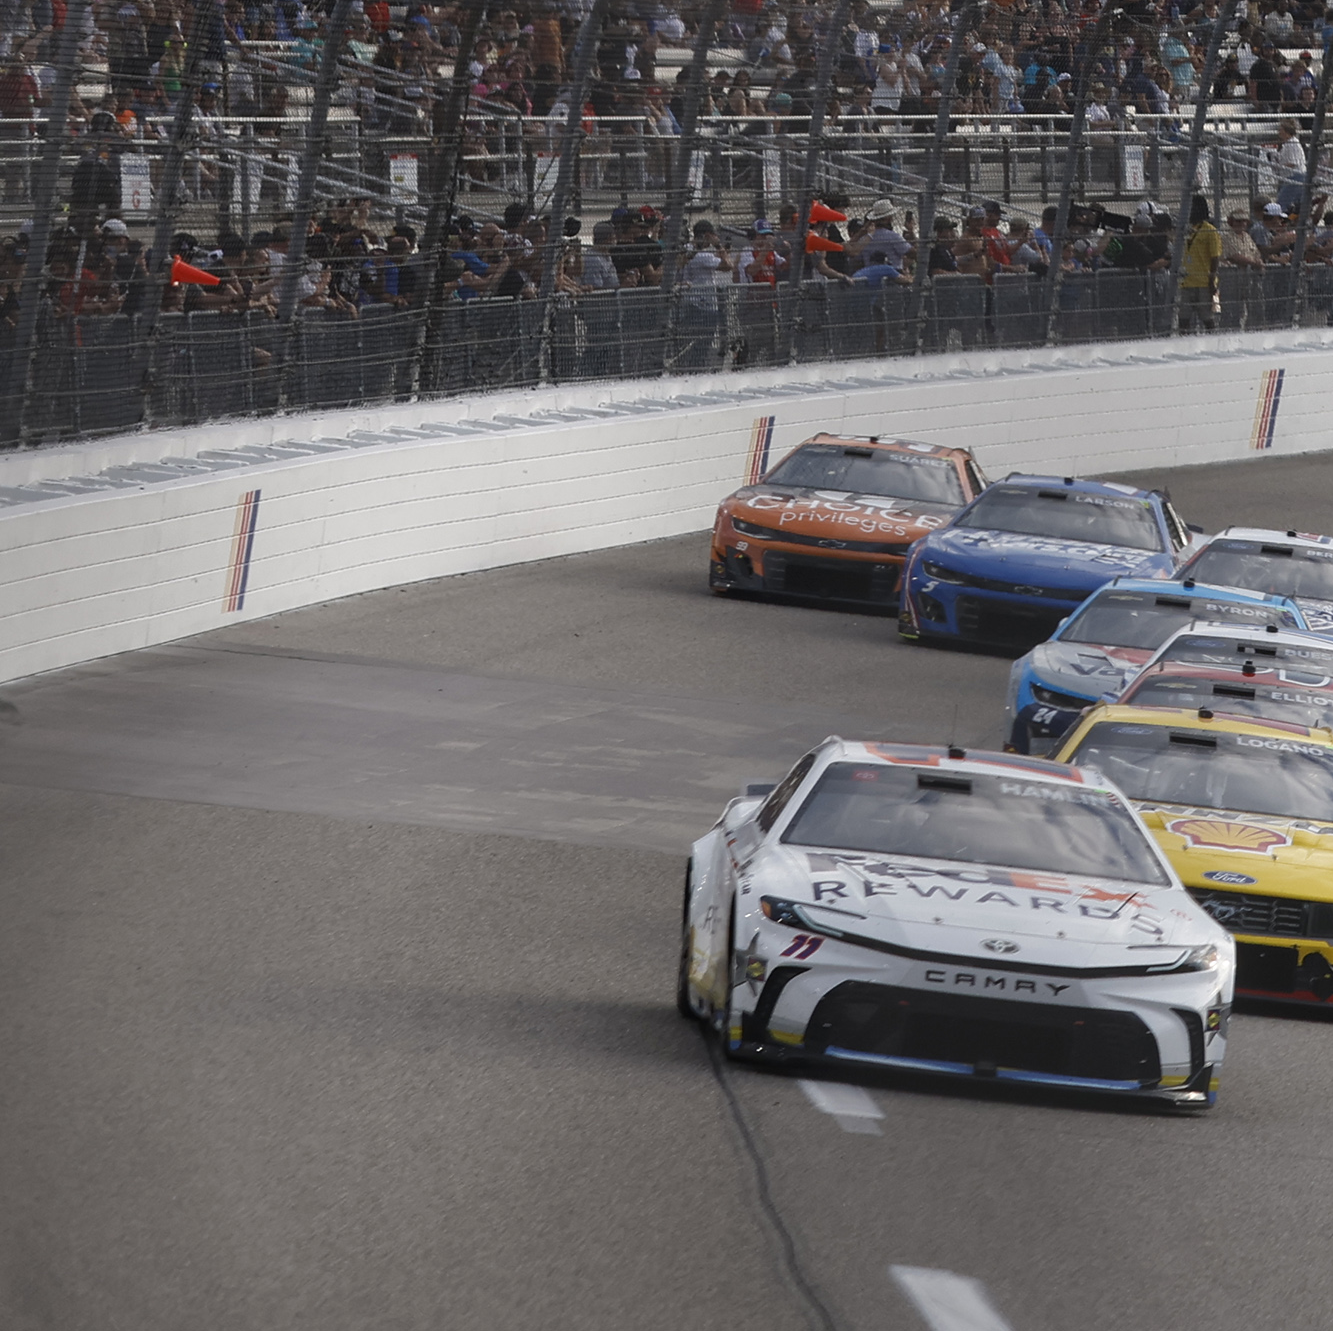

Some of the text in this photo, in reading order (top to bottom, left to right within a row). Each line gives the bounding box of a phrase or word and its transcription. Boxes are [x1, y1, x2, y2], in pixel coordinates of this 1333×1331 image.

[747, 495, 943, 530] CHOICE
[1075, 495, 1135, 510] LARSON
[779, 511, 907, 536] privileges
[922, 580, 940, 592] 5
[1205, 603, 1268, 619] BYRON
[1032, 707, 1058, 723] 24
[1236, 736, 1324, 756] LOGANO
[812, 880, 1165, 936] REWARDS
[780, 933, 826, 960] 11
[925, 969, 1071, 997] CAMRY
